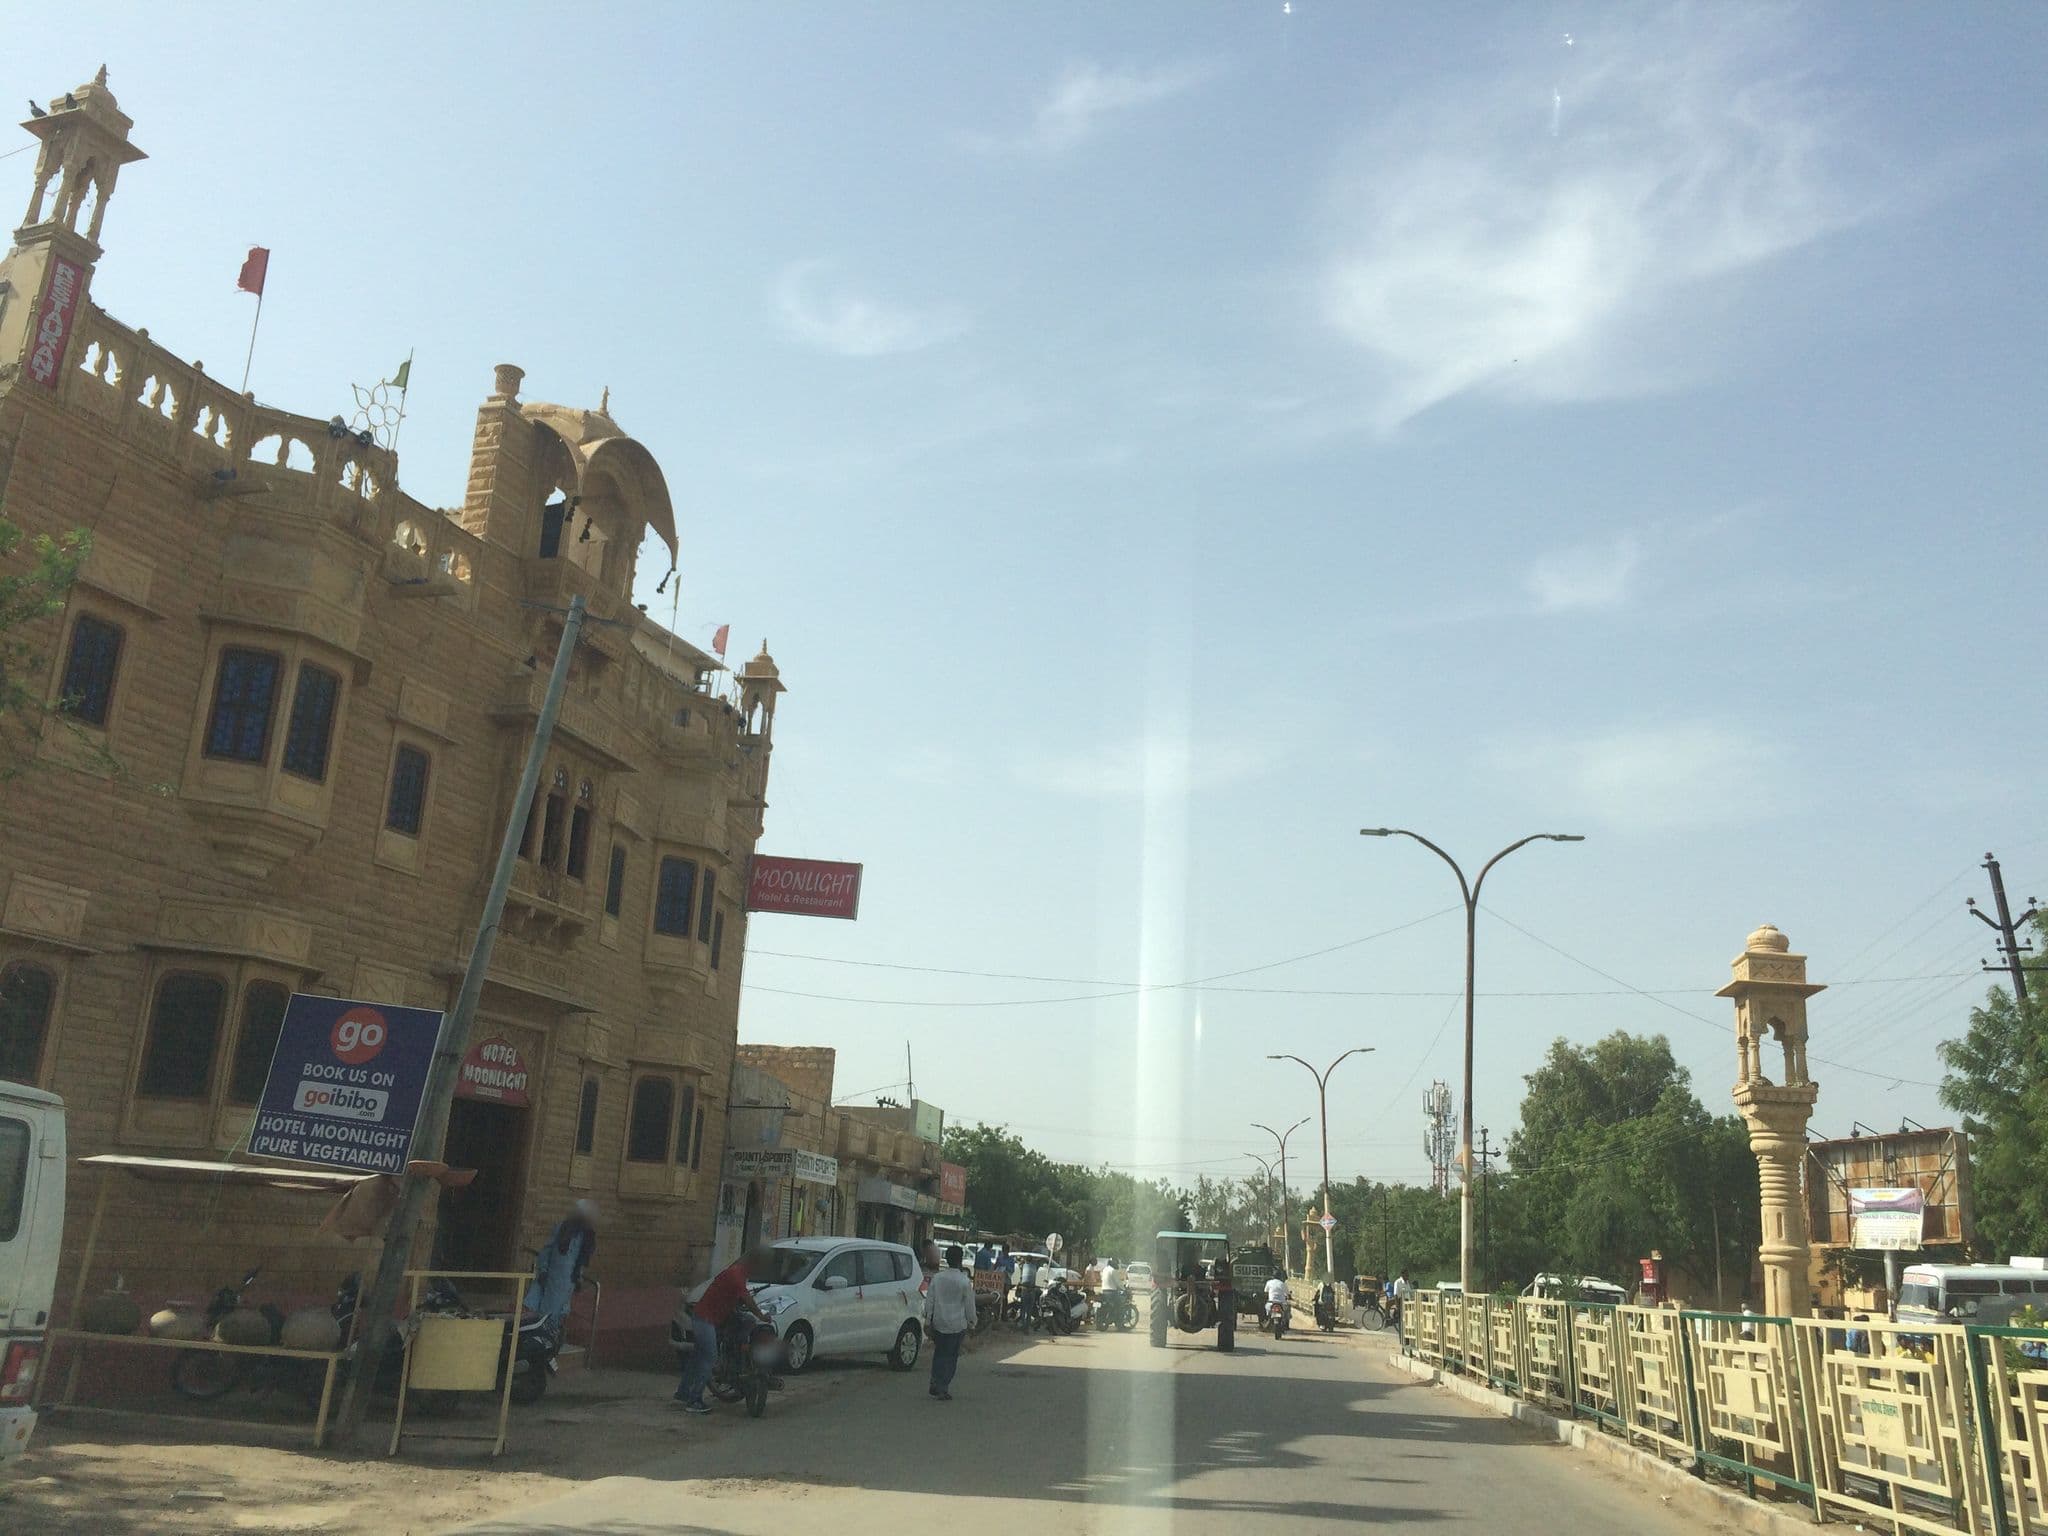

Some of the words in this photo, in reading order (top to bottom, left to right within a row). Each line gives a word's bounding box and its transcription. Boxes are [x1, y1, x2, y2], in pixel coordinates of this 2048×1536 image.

[31, 263, 75, 382] RESTAURANT
[753, 865, 854, 895] MOONLIGHT
[758, 890, 781, 903] Hotel
[792, 894, 843, 907] Restaurant
[336, 1021, 383, 1051] go
[483, 1044, 517, 1067] HOTEL
[303, 1063, 346, 1080] BOOK
[350, 1069, 368, 1083] US
[371, 1072, 395, 1087] ON
[464, 1064, 527, 1090] MOONLIGHT
[303, 1088, 378, 1112] goibibo
[259, 1116, 307, 1136] HOTEL
[310, 1123, 407, 1149] MOONLIGHT
[254, 1136, 299, 1155] (PURE
[302, 1141, 401, 1172] VEGETARIAN)
